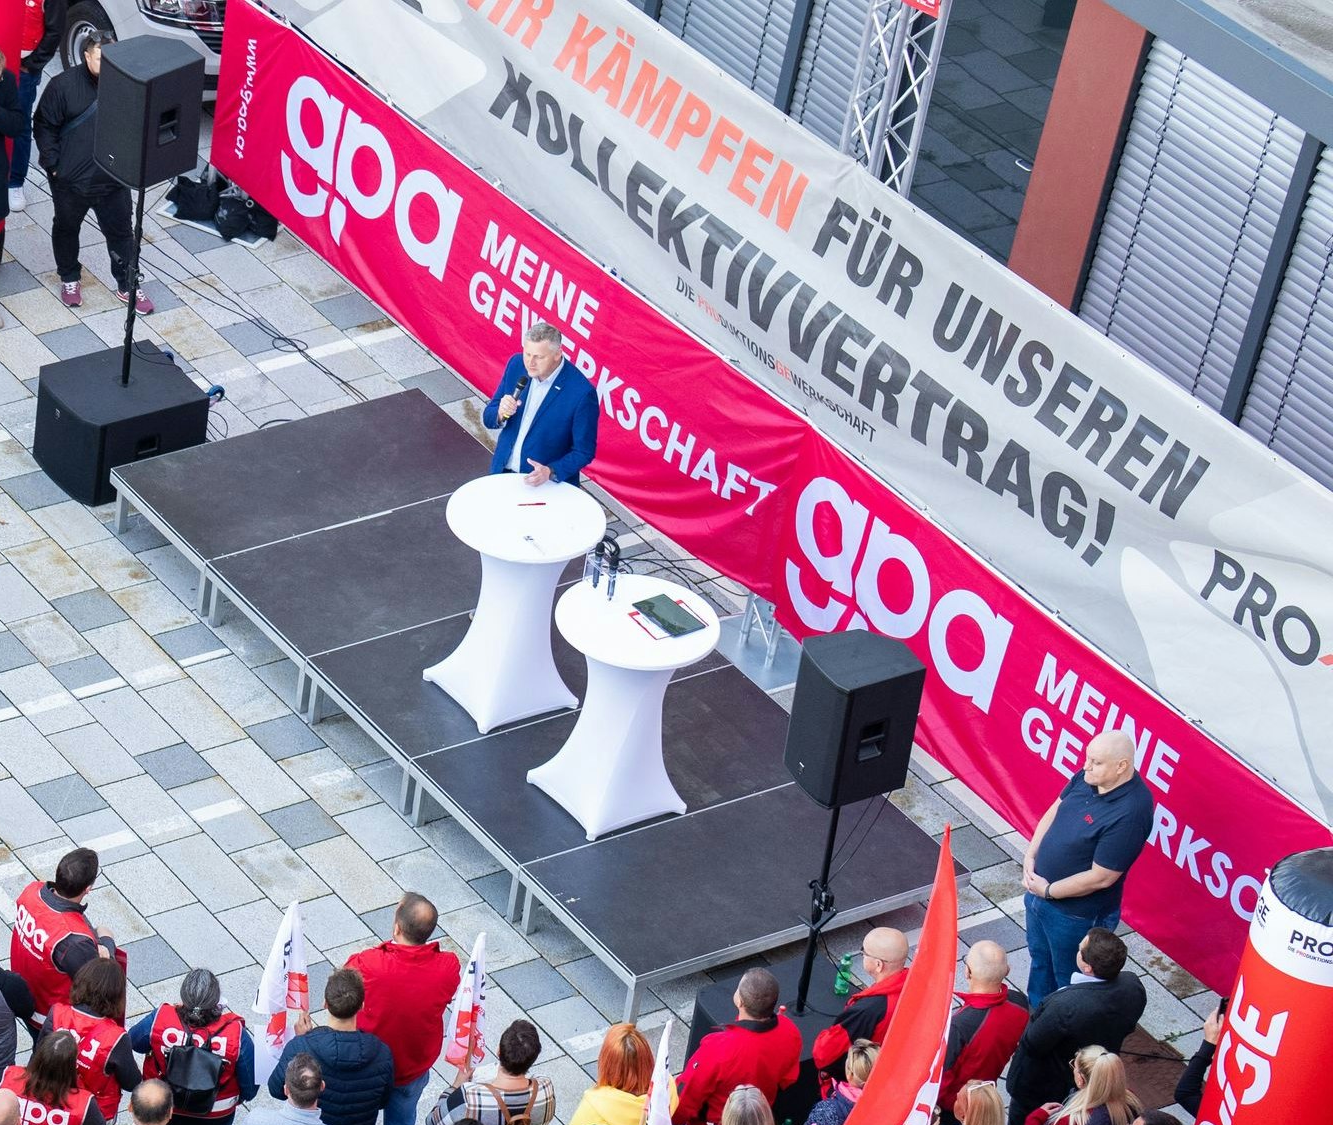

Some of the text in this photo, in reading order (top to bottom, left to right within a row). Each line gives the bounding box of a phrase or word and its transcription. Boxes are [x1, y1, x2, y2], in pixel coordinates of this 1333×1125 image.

[236, 39, 257, 160] www.gpa.at
[281, 76, 463, 283] gpa
[480, 222, 599, 320] MEINE
[489, 56, 1118, 568] KOLLEKTIVVERTRAG!
[552, 19, 809, 232] KÄMPFEN
[812, 197, 924, 316] FÜR
[931, 281, 1211, 519] UNSEREN
[674, 276, 877, 444] DIE PRODUKTIONSGEWERKSCHAFT
[784, 476, 1013, 705] gpa
[1035, 653, 1181, 794] MEINE
[16, 904, 49, 953] gpa
